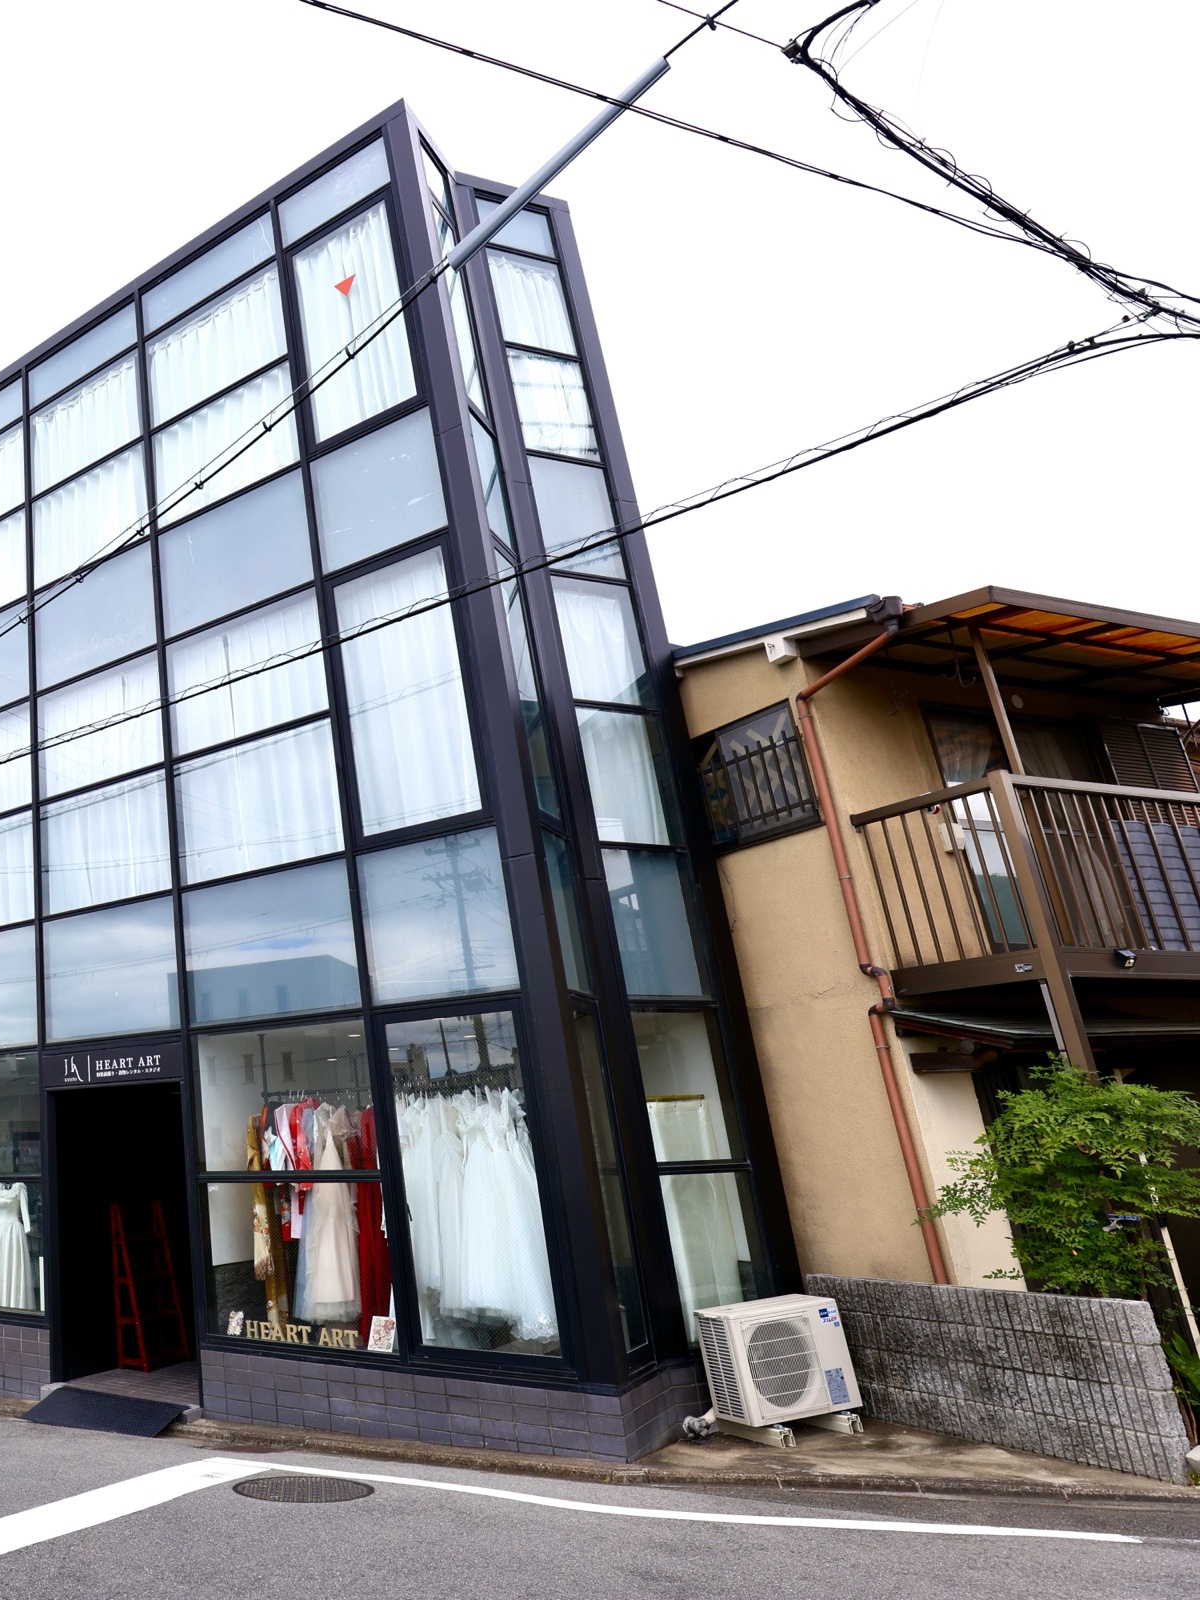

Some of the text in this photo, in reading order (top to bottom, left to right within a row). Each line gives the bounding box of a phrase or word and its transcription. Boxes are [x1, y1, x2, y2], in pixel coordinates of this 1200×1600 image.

[95, 1054, 161, 1071] HEART ART
[246, 1320, 359, 1349] HEART ART
